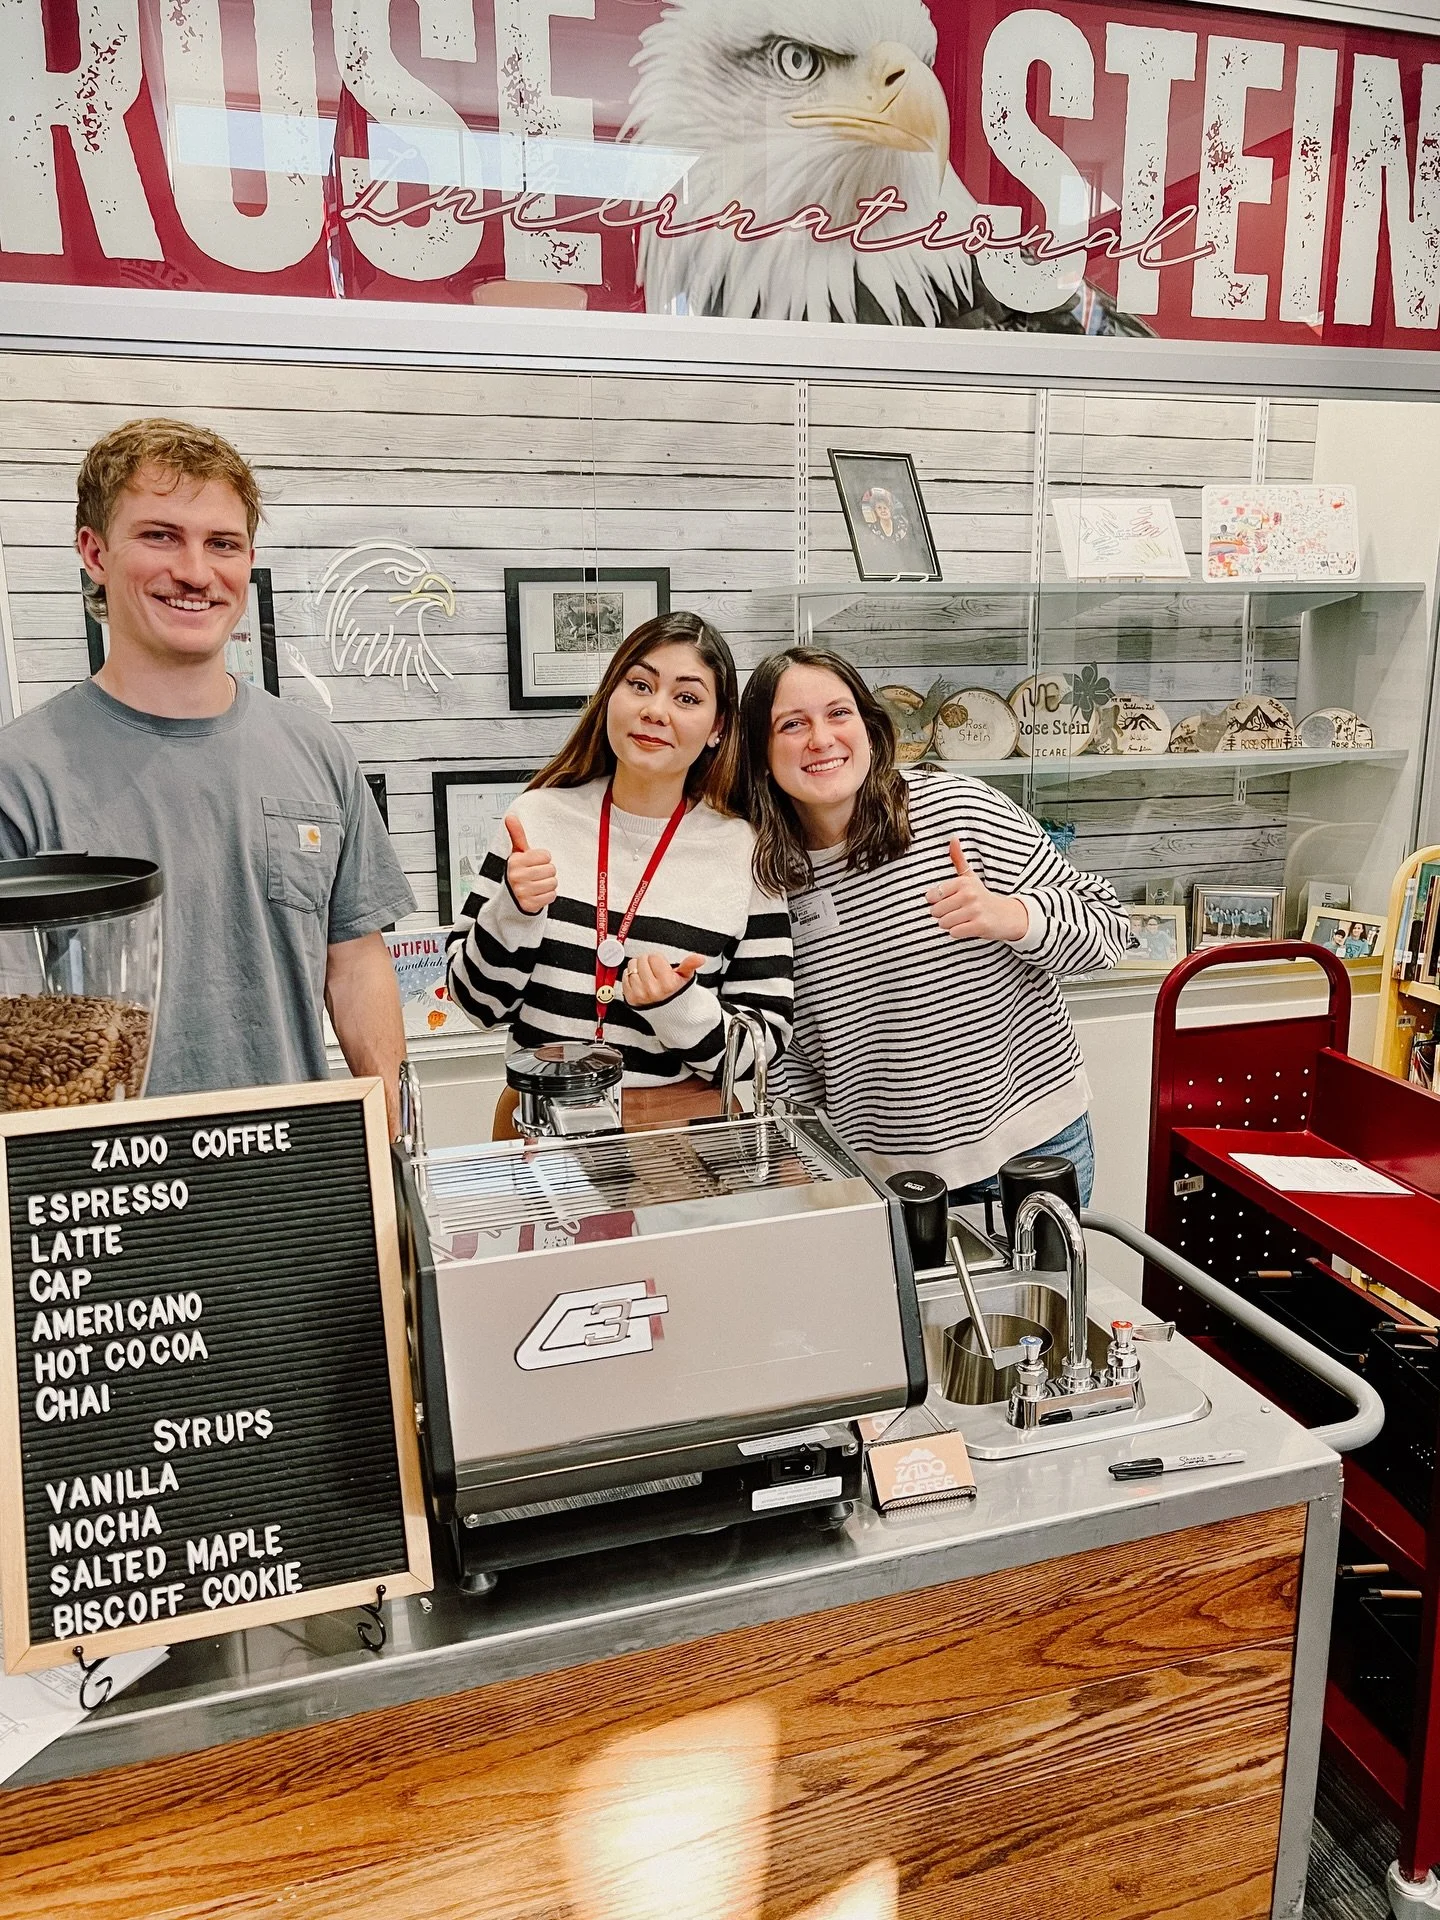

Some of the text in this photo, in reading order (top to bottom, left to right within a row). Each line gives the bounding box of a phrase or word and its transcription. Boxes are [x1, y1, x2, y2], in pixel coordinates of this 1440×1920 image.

[977, 8, 1440, 329] STEIN
[958, 729, 991, 742] Stein
[965, 719, 988, 730] Rose
[1019, 720, 1090, 736] Rose Stein
[1260, 738, 1283, 750] STEIN
[388, 939, 439, 958] UTIFUL
[394, 957, 443, 972] anukkah
[91, 1122, 292, 1171] ZADO COFFEE
[28, 1179, 189, 1226] ESPRESSO
[31, 1225, 123, 1264] LATTE
[29, 1269, 92, 1303] CAP
[32, 1291, 203, 1343] AMERICANO
[35, 1331, 208, 1384] HOT COCOA
[35, 1384, 110, 1423] CHAI
[153, 1409, 274, 1454] SYRUPS
[46, 1462, 180, 1514] VANILLA
[892, 1474, 956, 1497] COFFEE
[894, 1459, 947, 1483] ZADO
[49, 1505, 163, 1556] MOCHA
[50, 1525, 284, 1596] SALTED MAPLE
[52, 1561, 303, 1639] BISCOFF COOKIE
